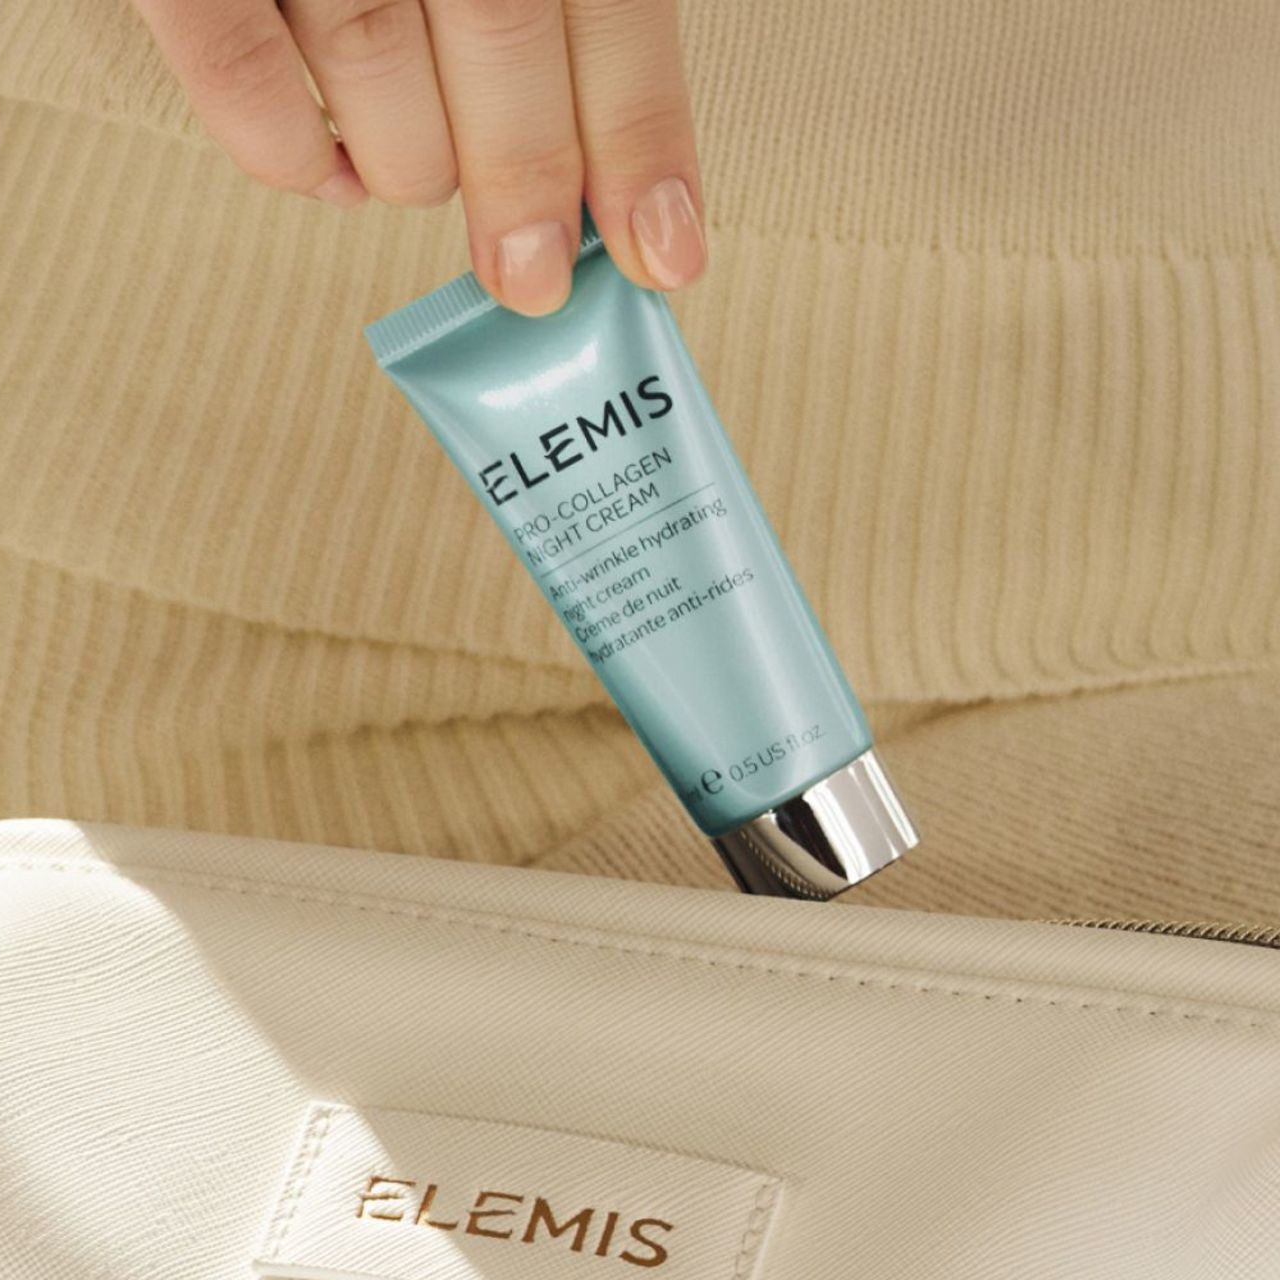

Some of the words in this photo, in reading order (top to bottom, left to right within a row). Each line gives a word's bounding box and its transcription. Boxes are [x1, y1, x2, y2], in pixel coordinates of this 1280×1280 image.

[479, 375, 673, 505] ELEMIS
[513, 446, 672, 542] PRO-COLLAGEN
[527, 526, 583, 567] NIGHT
[585, 482, 660, 532] CREAM
[549, 544, 640, 601] Anti-wrinkle
[639, 498, 727, 552] hydrating
[596, 566, 651, 603] cream
[622, 597, 645, 617] de
[646, 576, 682, 605] nuit
[669, 567, 754, 621] anti-rides
[757, 742, 786, 767] US
[355, 1175, 674, 1268] ELEMIS
